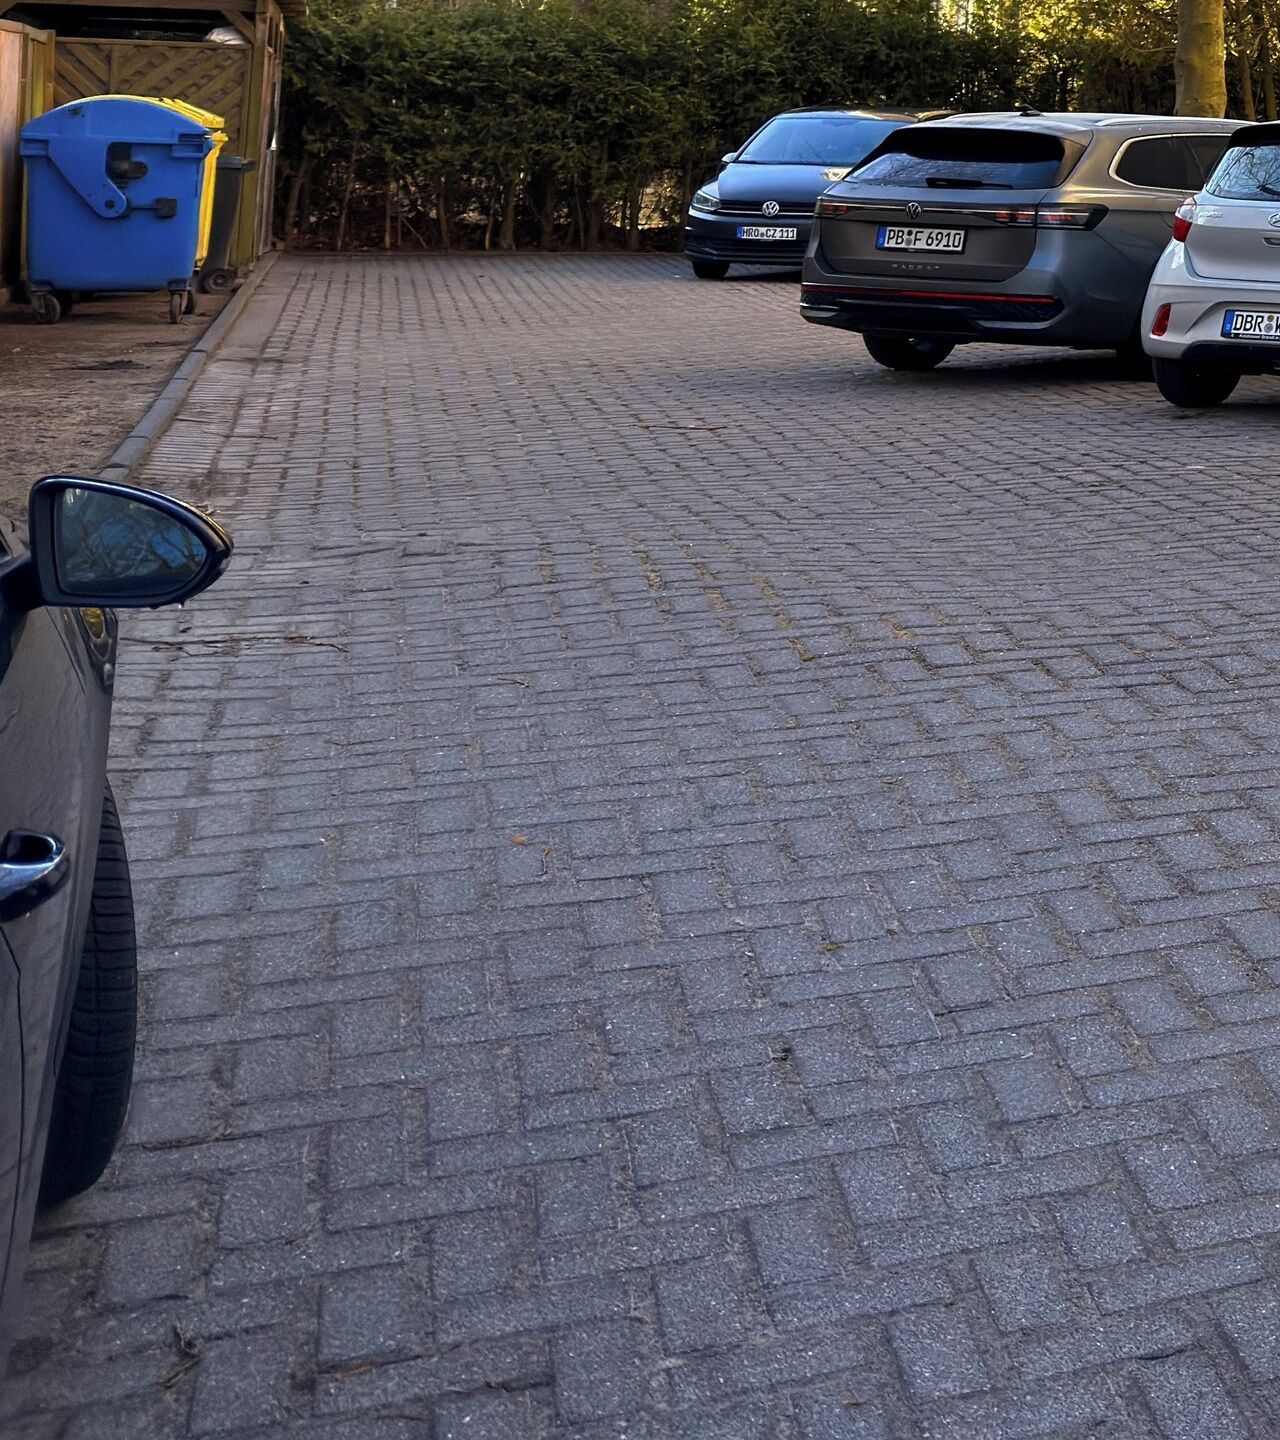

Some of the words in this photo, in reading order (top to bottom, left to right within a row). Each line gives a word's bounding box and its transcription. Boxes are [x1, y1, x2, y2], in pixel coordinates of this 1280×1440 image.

[742, 228, 760, 238] HRO
[765, 228, 778, 239] CZ
[778, 228, 795, 239] 111
[886, 229, 905, 245] PB
[913, 230, 925, 246] F
[925, 231, 962, 248] 6910
[1232, 314, 1264, 332] DBR
